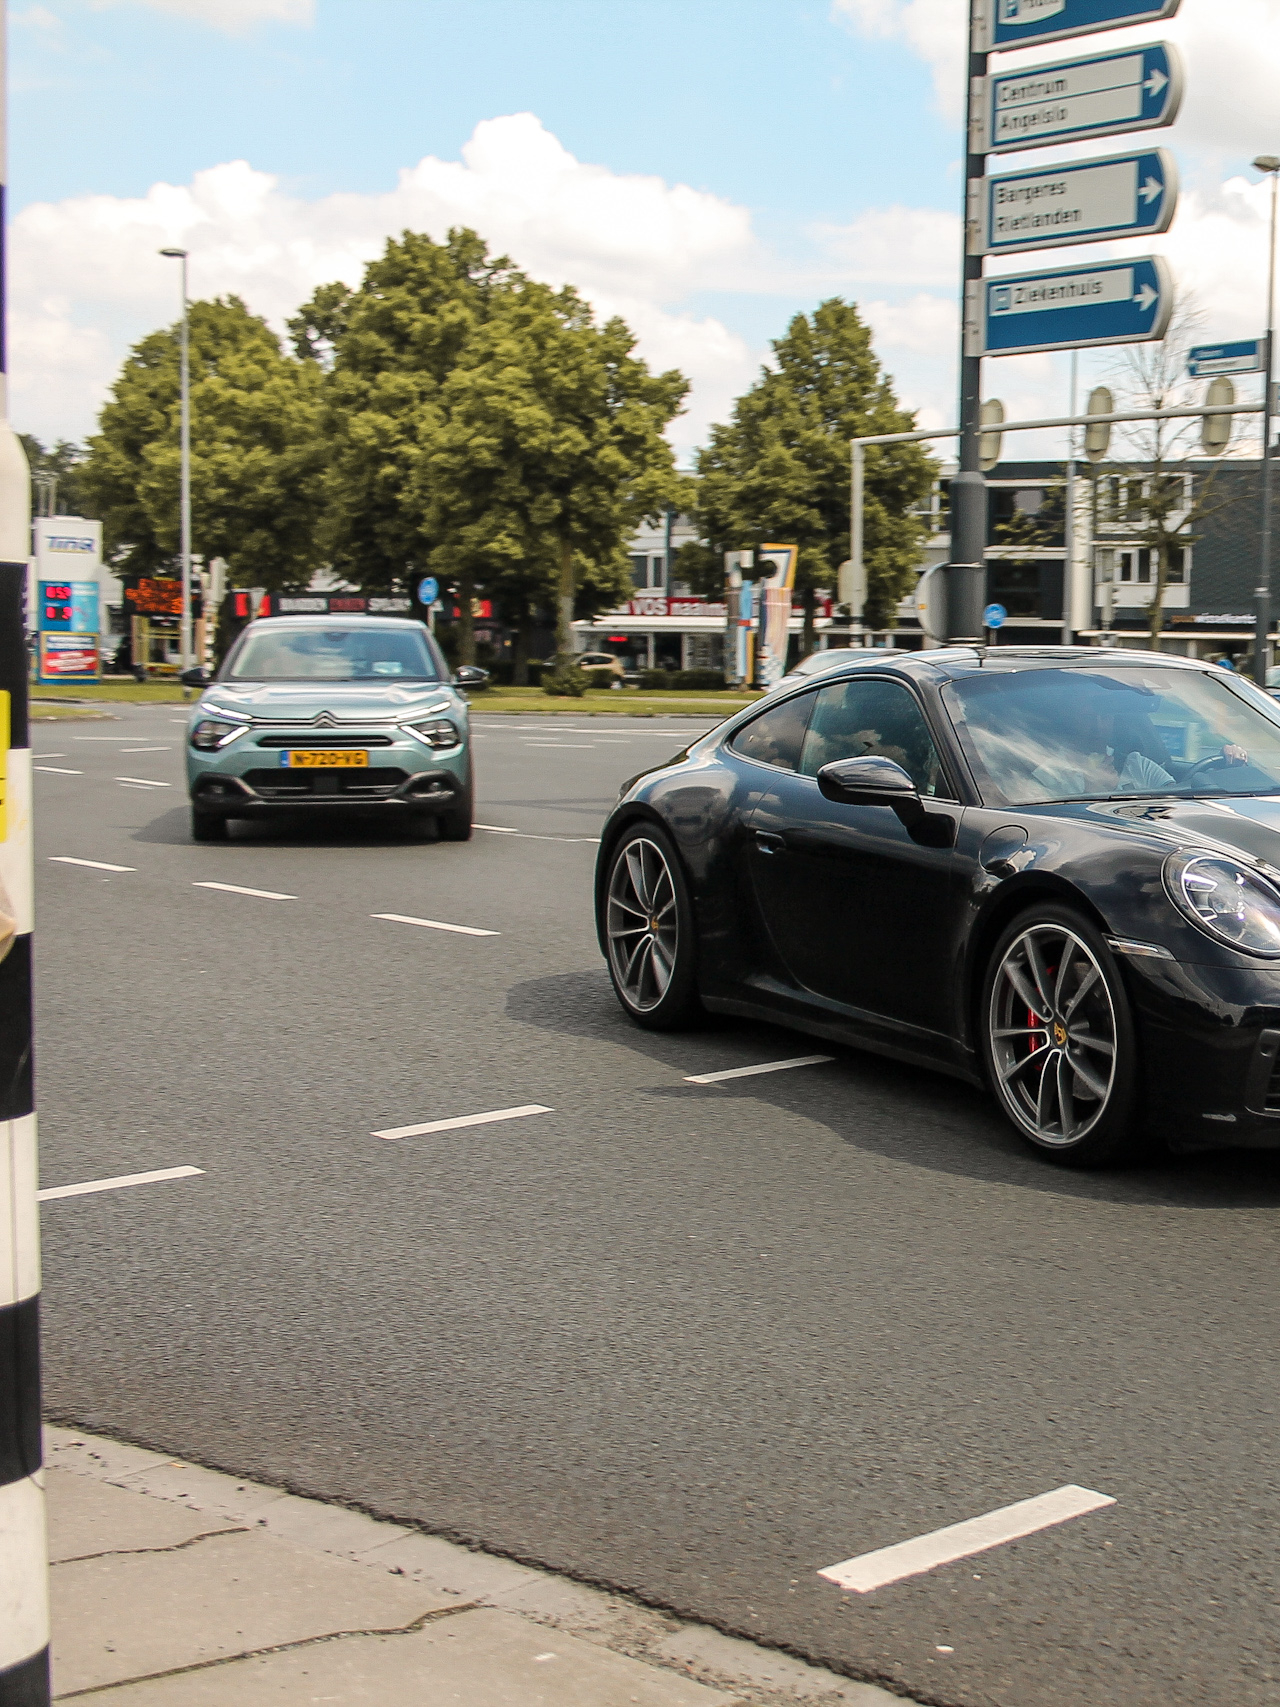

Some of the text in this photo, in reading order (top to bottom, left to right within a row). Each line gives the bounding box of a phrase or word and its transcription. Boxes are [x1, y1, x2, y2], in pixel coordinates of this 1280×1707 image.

[1001, 78, 1066, 103] Centrum
[1000, 107, 1067, 132] Angelslo
[997, 181, 1066, 205] Bargeres
[996, 208, 1081, 234] Rietlanden
[1013, 278, 1103, 304] Ziekenhuis
